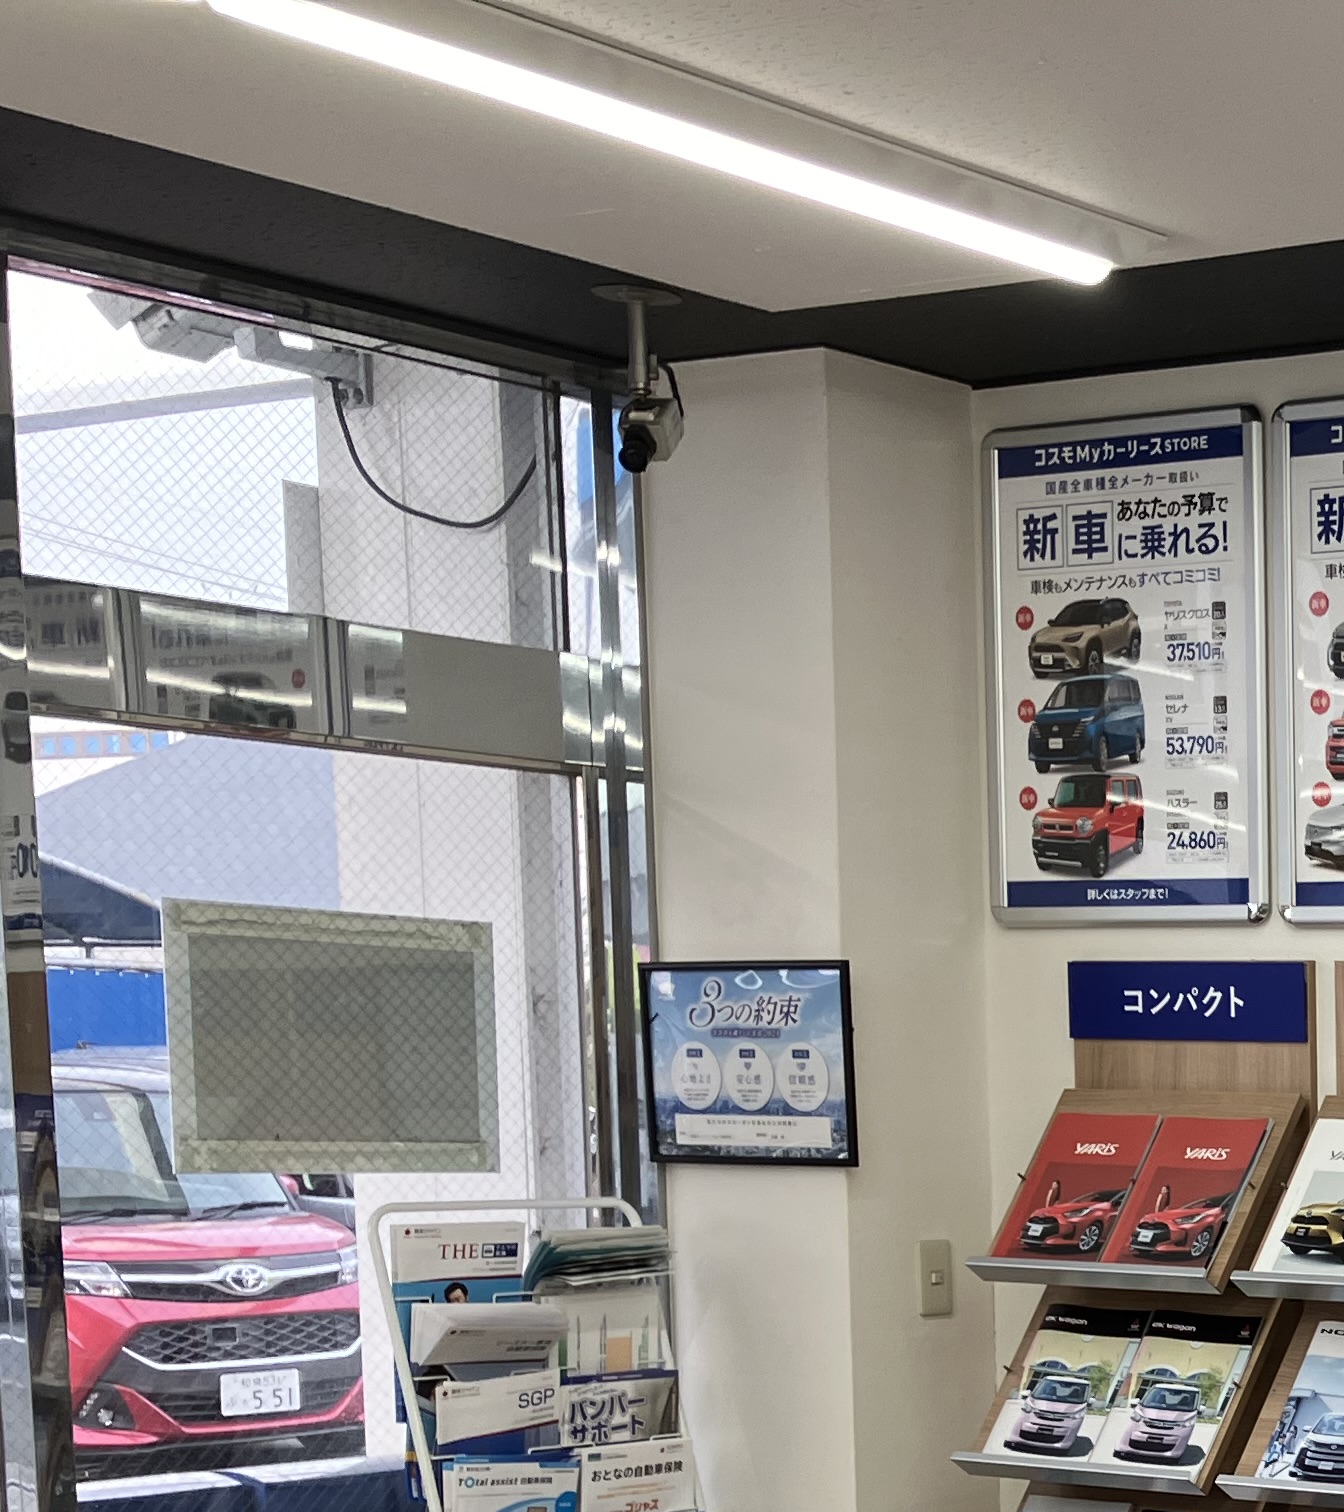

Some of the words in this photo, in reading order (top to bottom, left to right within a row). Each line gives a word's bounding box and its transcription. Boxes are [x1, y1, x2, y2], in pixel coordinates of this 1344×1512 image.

[1034, 435, 1209, 468] コスモMyカーリースSTORE
[1117, 493, 1229, 521] あなたの予算で
[1118, 521, 1229, 560] に乗れる!
[689, 979, 801, 1028] 3つの約束
[1123, 985, 1245, 1018] コンパクト
[438, 1243, 479, 1260] THE
[518, 1388, 555, 1409] SGP
[570, 1392, 646, 1423] バンパー
[591, 1461, 683, 1482] おとなの自動車保険
